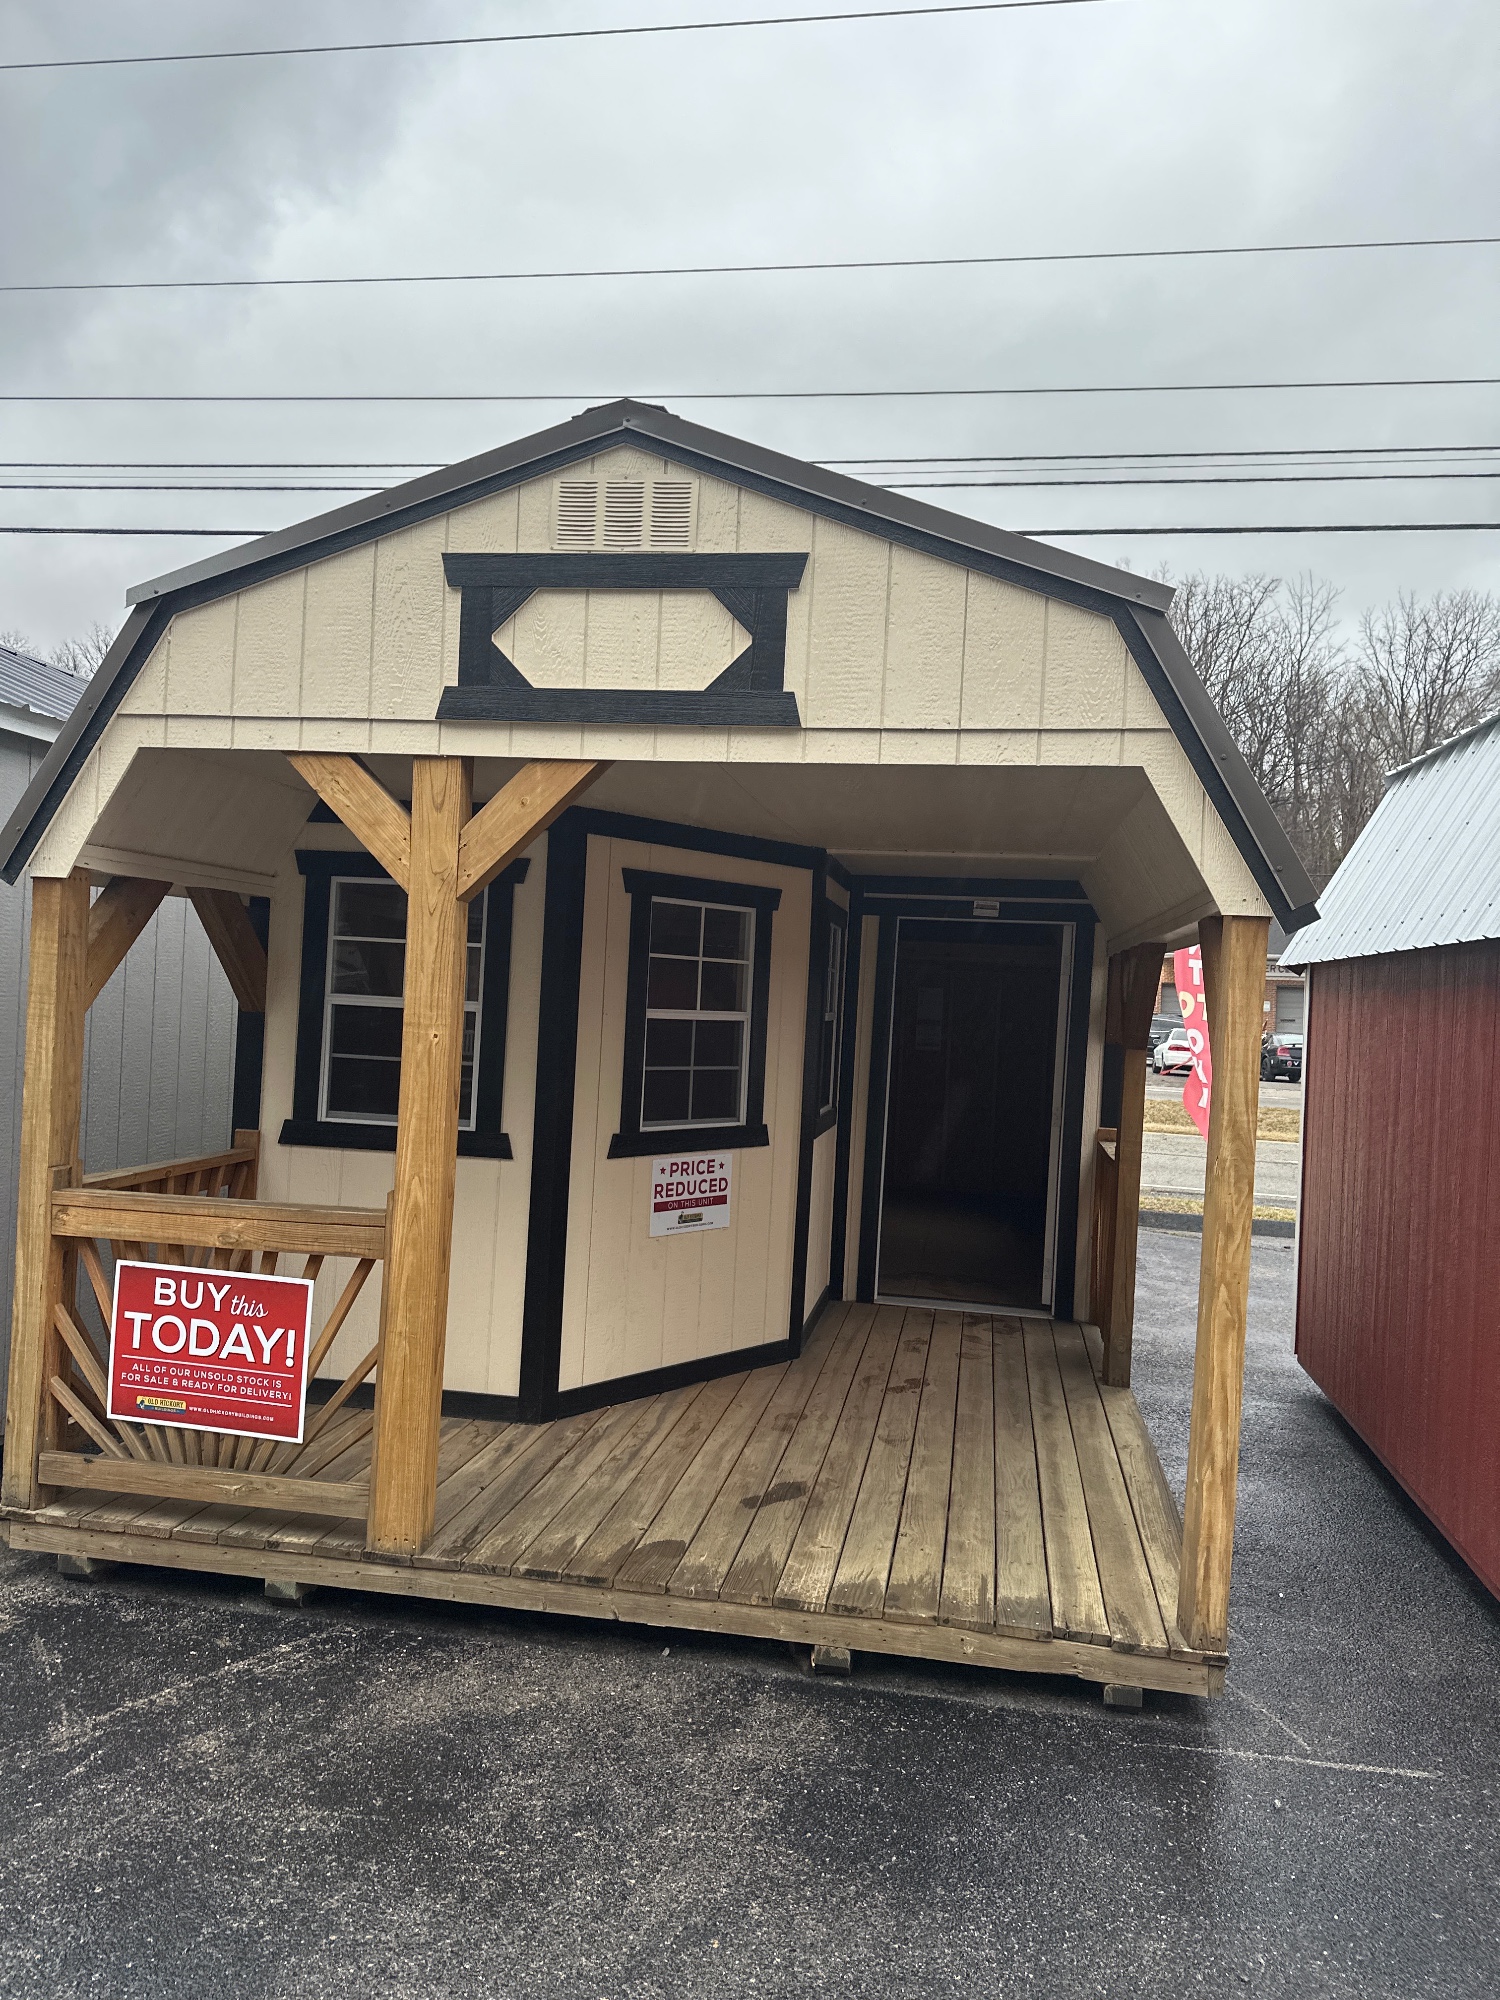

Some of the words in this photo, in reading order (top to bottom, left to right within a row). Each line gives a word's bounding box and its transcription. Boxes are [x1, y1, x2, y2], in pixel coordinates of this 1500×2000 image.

[669, 1159, 716, 1178] PRICE
[653, 1177, 729, 1200] REDUCED
[667, 1202, 679, 1210] ON
[681, 1199, 696, 1208] THIS
[698, 1197, 714, 1206] UNIT
[153, 1276, 232, 1312] BUY
[230, 1294, 269, 1318] this
[124, 1310, 296, 1368] TODAY!
[121, 1372, 141, 1382] FOR
[143, 1375, 169, 1386] SALE
[172, 1378, 178, 1387] &
[181, 1379, 215, 1391] READY
[217, 1383, 237, 1394] FOR
[239, 1387, 292, 1401] DELIVERY!
[132, 1362, 151, 1373] ALL
[153, 1365, 167, 1375] OF
[169, 1366, 191, 1378] OUR
[193, 1371, 234, 1383] UNSOLD
[236, 1375, 269, 1388] STOCK
[272, 1379, 282, 1389] IS
[159, 1400, 184, 1408] HICKORY
